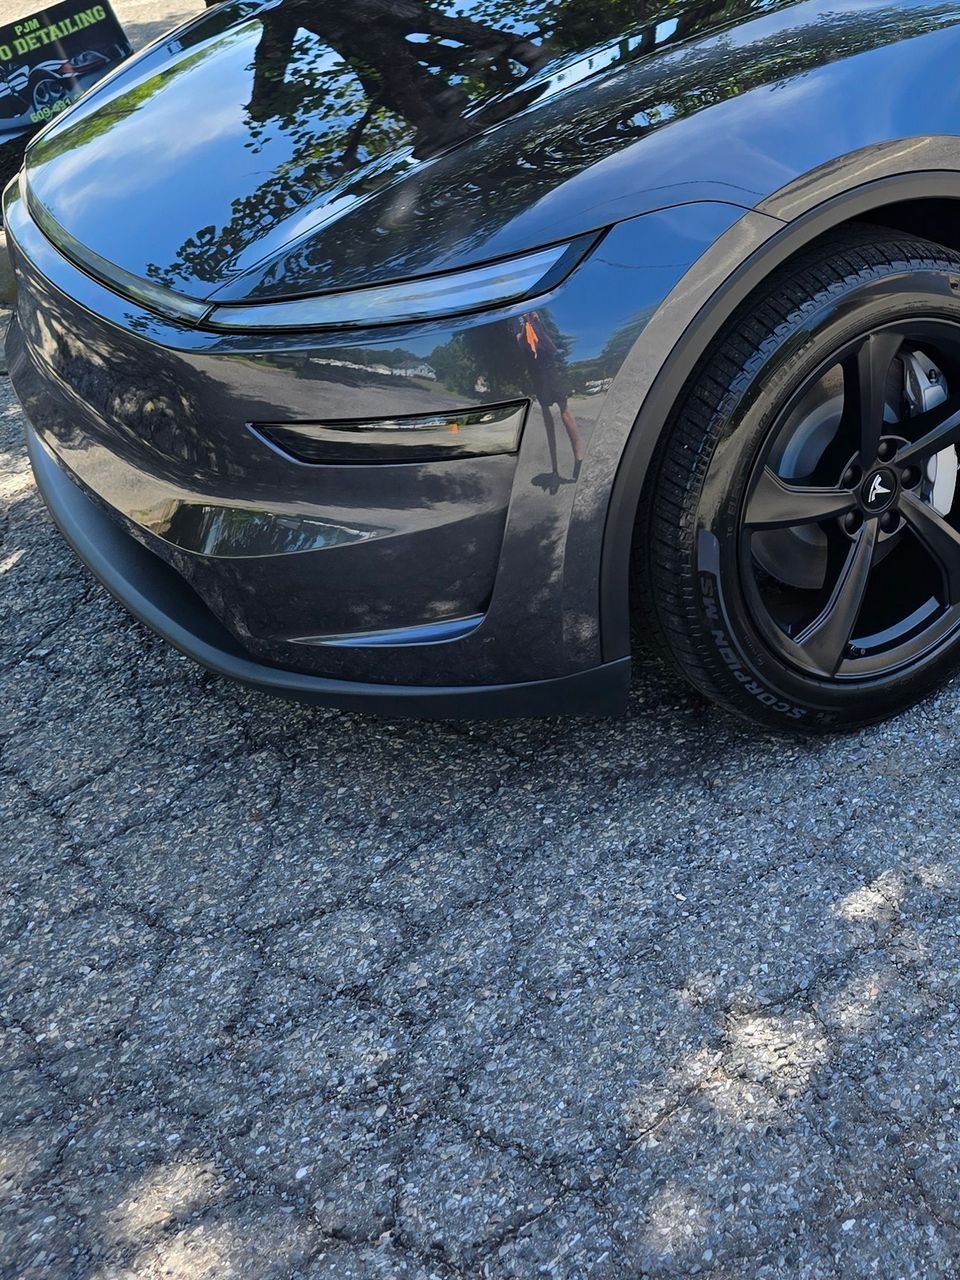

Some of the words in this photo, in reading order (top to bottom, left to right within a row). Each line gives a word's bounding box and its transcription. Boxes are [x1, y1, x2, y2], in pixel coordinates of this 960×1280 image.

[13, 4, 107, 56] DETAILING
[14, 18, 40, 36] PJM
[711, 629, 807, 719] SCORPION
